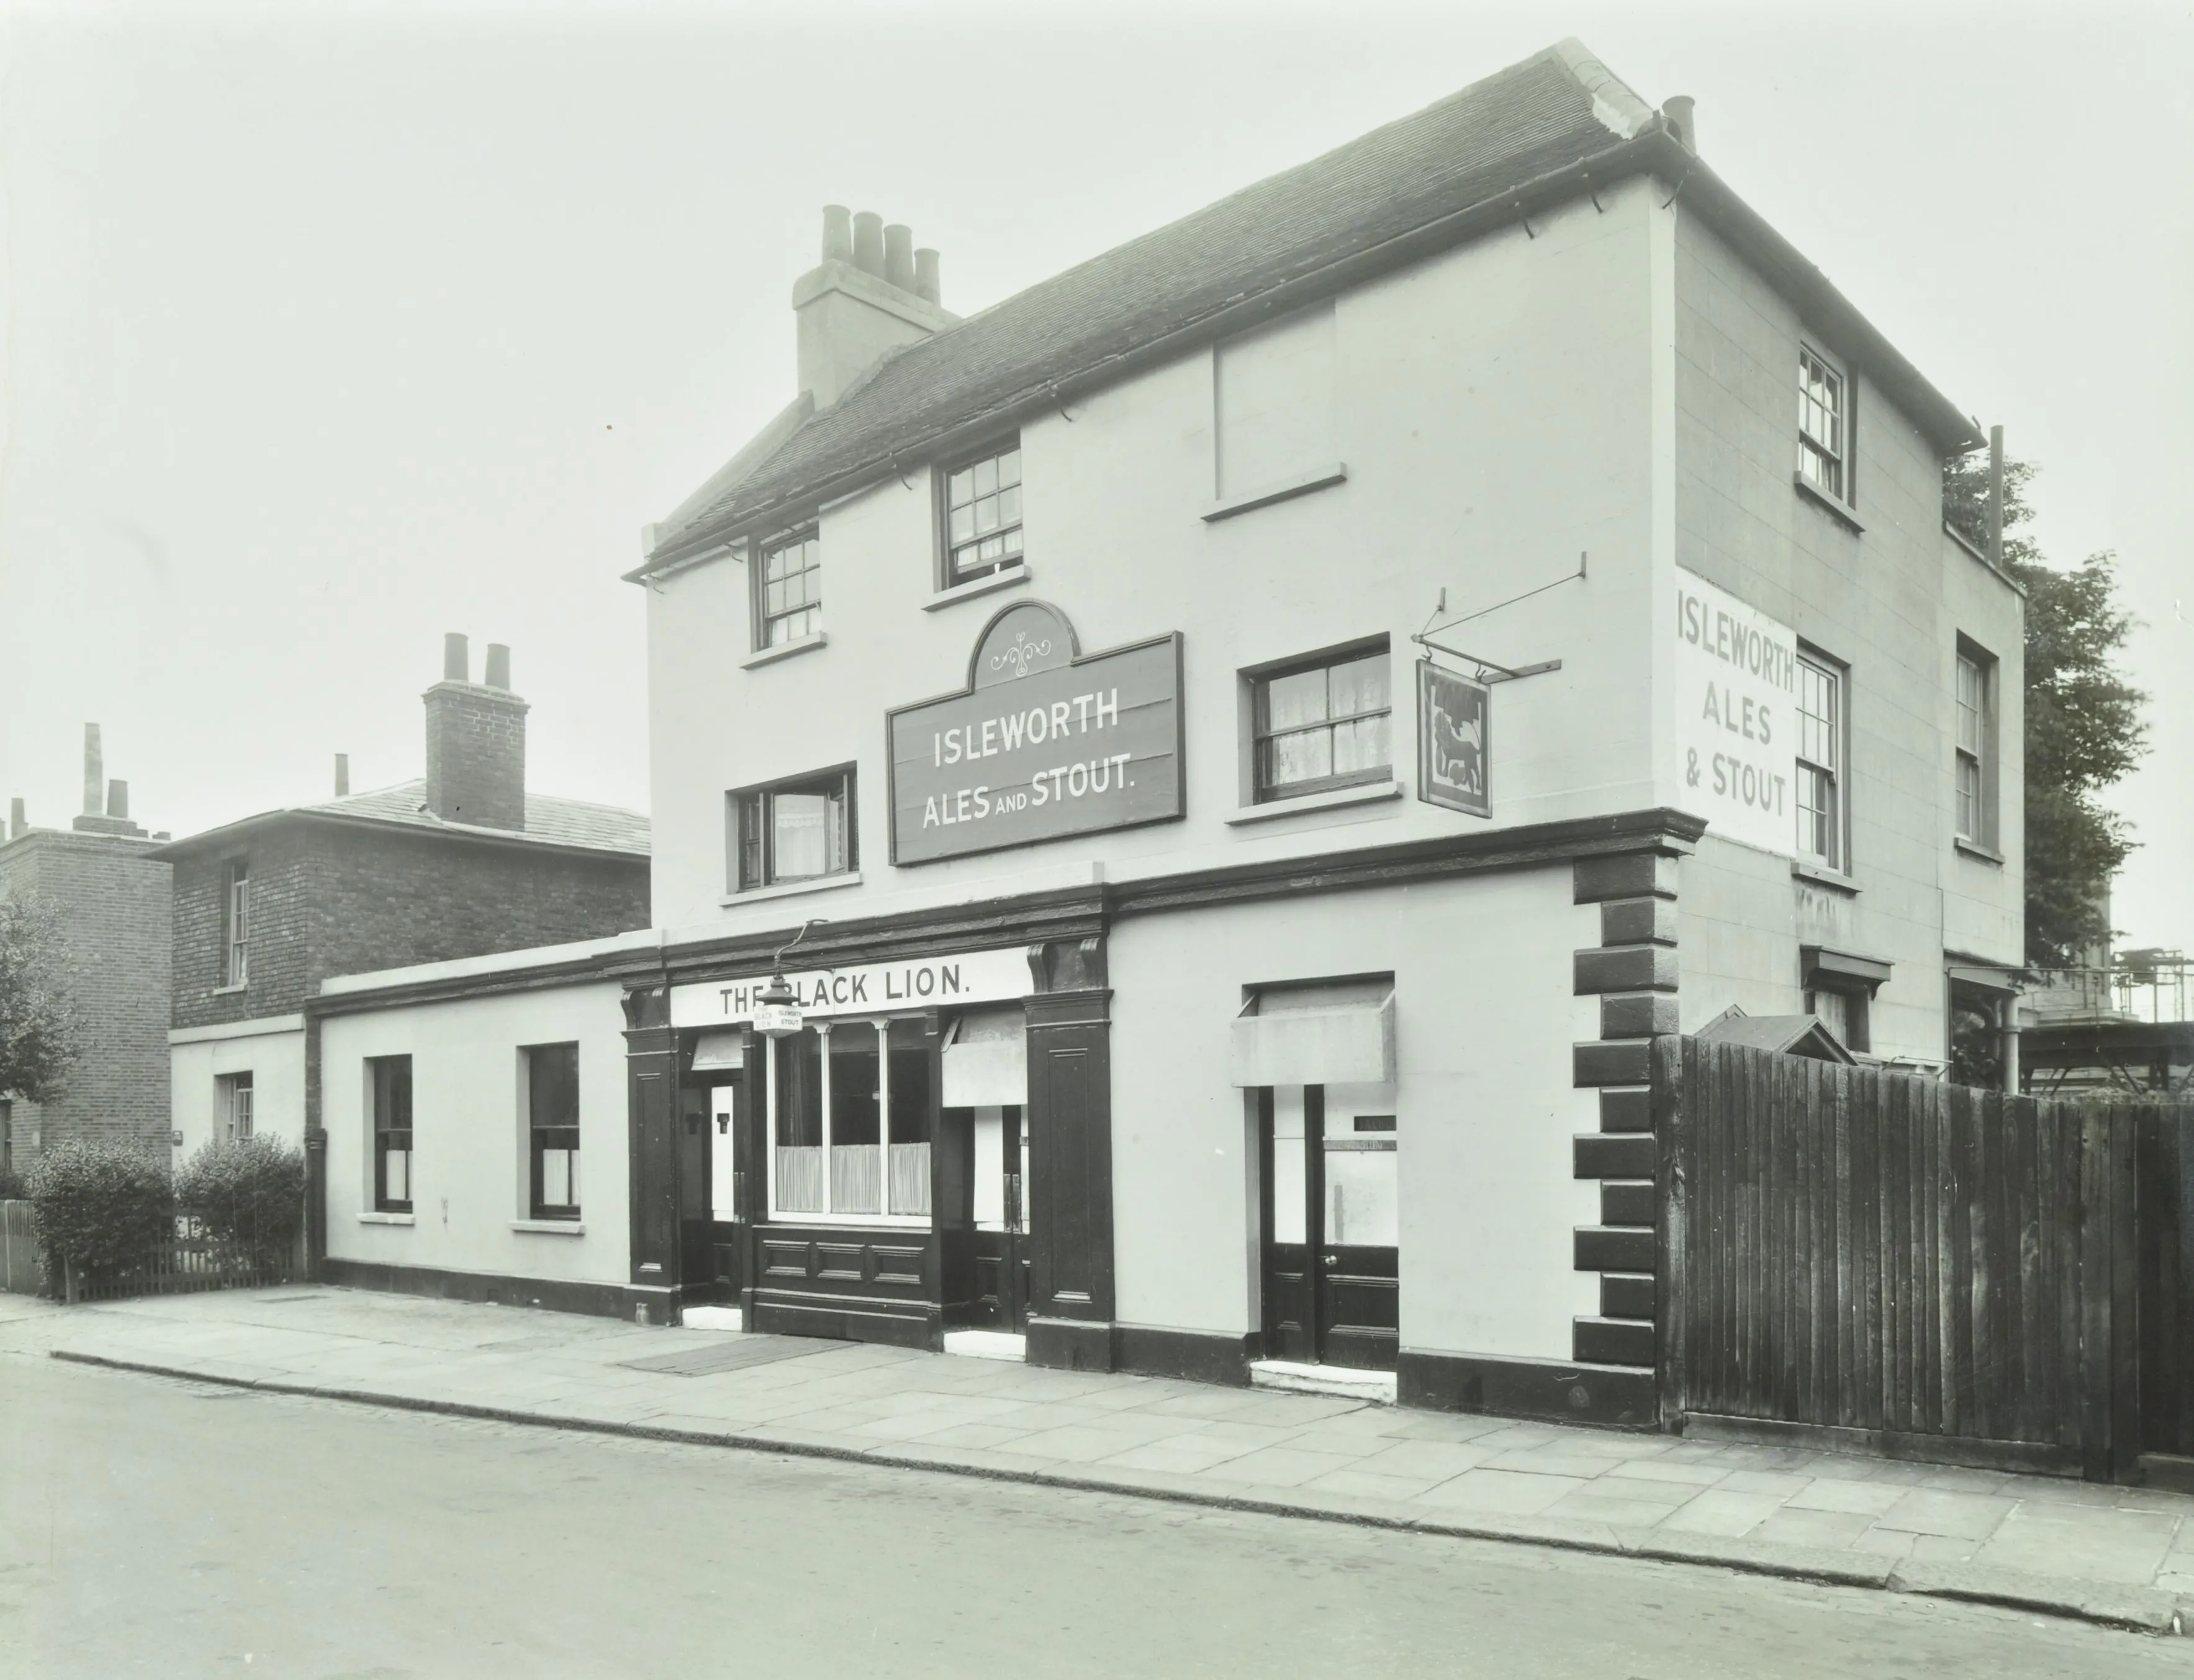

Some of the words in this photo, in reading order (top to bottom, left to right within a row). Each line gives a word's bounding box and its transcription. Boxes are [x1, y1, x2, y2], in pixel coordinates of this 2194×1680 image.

[1678, 590, 1794, 693] ISLEWORTH
[934, 687, 1119, 767] ISLEWORTH
[1702, 680, 1772, 746] ALES
[923, 786, 991, 829] ALES
[995, 792, 1027, 816] AND
[1031, 753, 1135, 806] STOUT.
[1687, 746, 1700, 788] &
[1712, 752, 1785, 817] STOUT
[886, 964, 971, 1000] LION.
